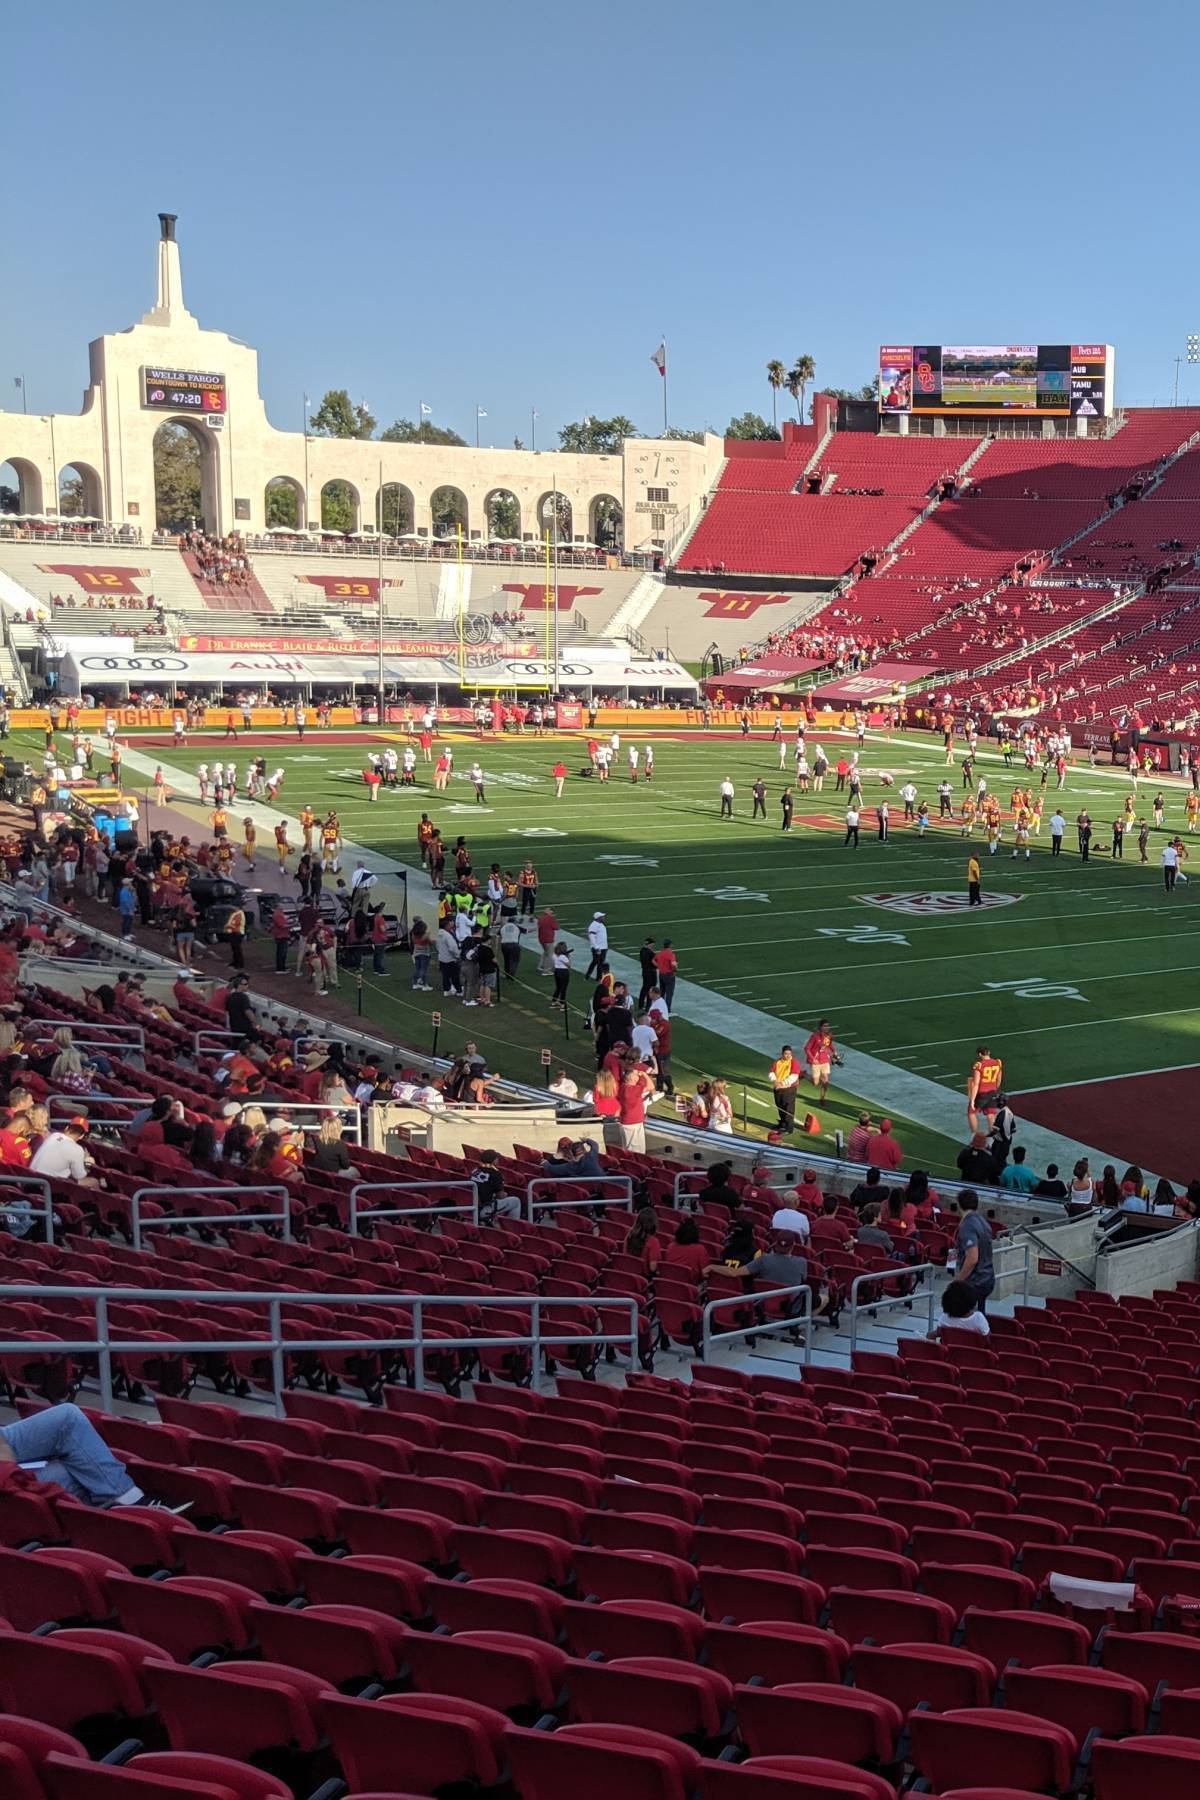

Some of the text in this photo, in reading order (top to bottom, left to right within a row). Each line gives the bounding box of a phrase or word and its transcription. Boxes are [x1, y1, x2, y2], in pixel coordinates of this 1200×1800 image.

[151, 370, 220, 384] WELLS FARGO
[146, 378, 188, 388] COUNTDOWN
[198, 382, 225, 391] KICKOFF
[1072, 381, 1092, 389] TAMU
[171, 393, 201, 405] 47:20
[83, 572, 124, 586] 12
[334, 583, 370, 595] 33
[283, 641, 314, 651] BLAIR
[315, 641, 324, 651] &
[328, 642, 357, 651] RUTH
[405, 644, 438, 654] FAMILY
[447, 649, 504, 668] Allstate
[229, 661, 304, 670] Audi
[623, 663, 682, 676] Audi
[323, 829, 337, 839] 59
[814, 924, 902, 945] 20
[982, 977, 1080, 999] 10
[982, 1065, 1000, 1085] 97
